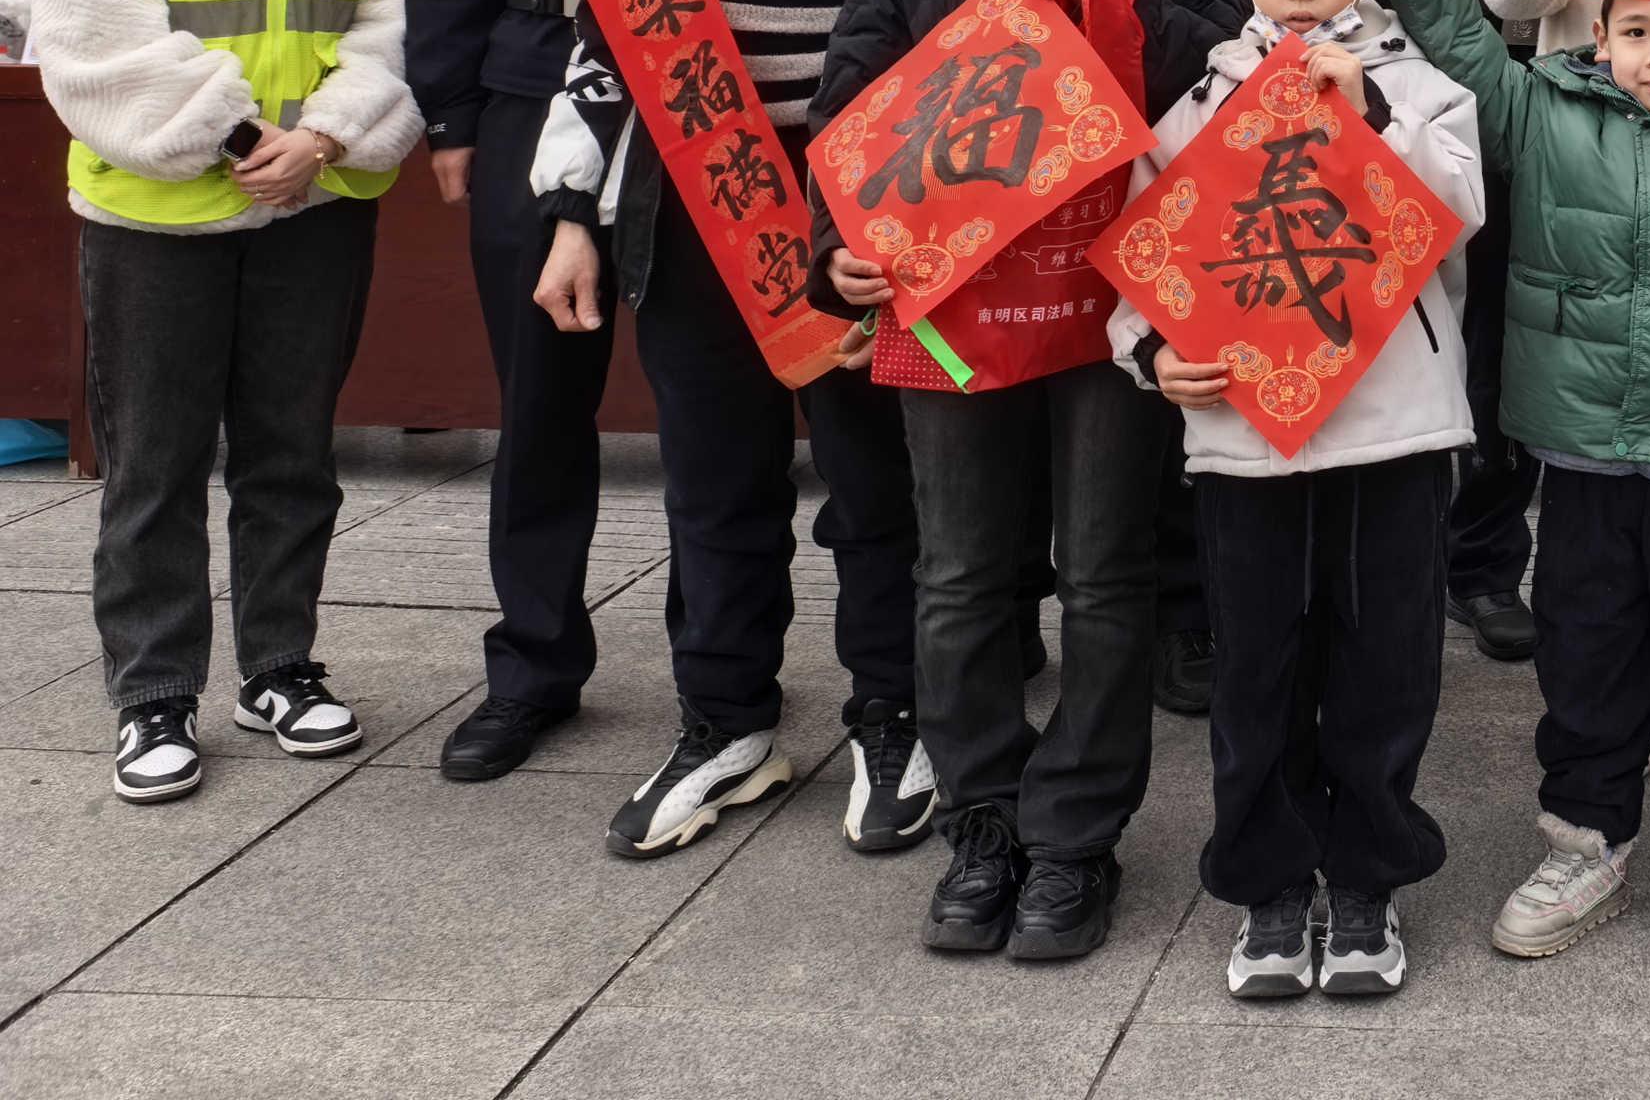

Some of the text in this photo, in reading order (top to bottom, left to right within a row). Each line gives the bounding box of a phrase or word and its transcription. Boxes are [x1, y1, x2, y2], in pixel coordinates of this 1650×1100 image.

[856, 41, 1044, 211] 福
[978, 301, 1074, 325] 南明区司法局
